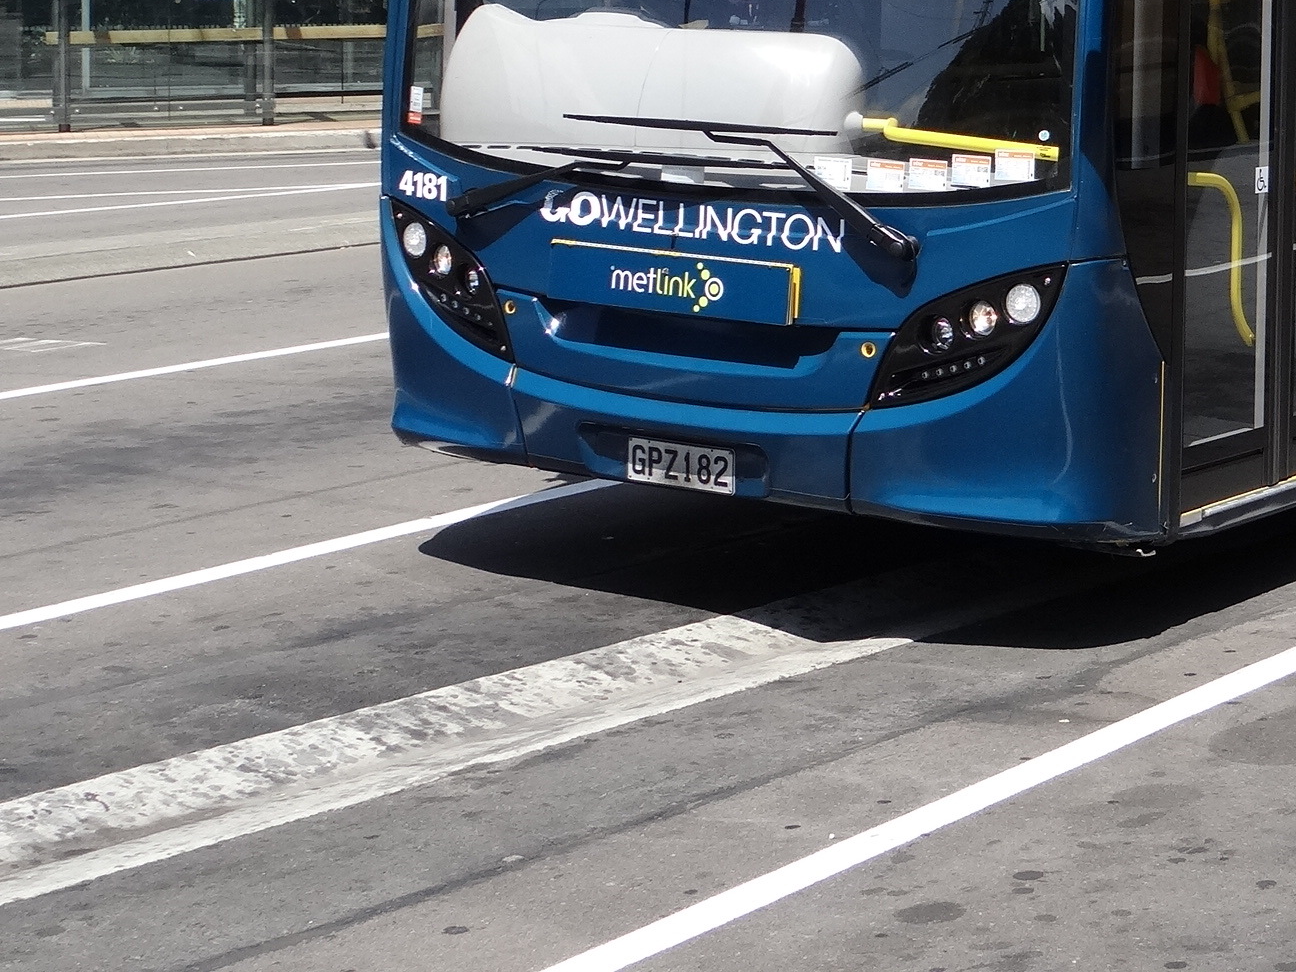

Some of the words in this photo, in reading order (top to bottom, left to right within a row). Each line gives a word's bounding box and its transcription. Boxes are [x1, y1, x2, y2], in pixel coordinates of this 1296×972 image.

[399, 170, 448, 201] 4181
[610, 267, 696, 299] metlink
[631, 444, 729, 488] GPZ182
